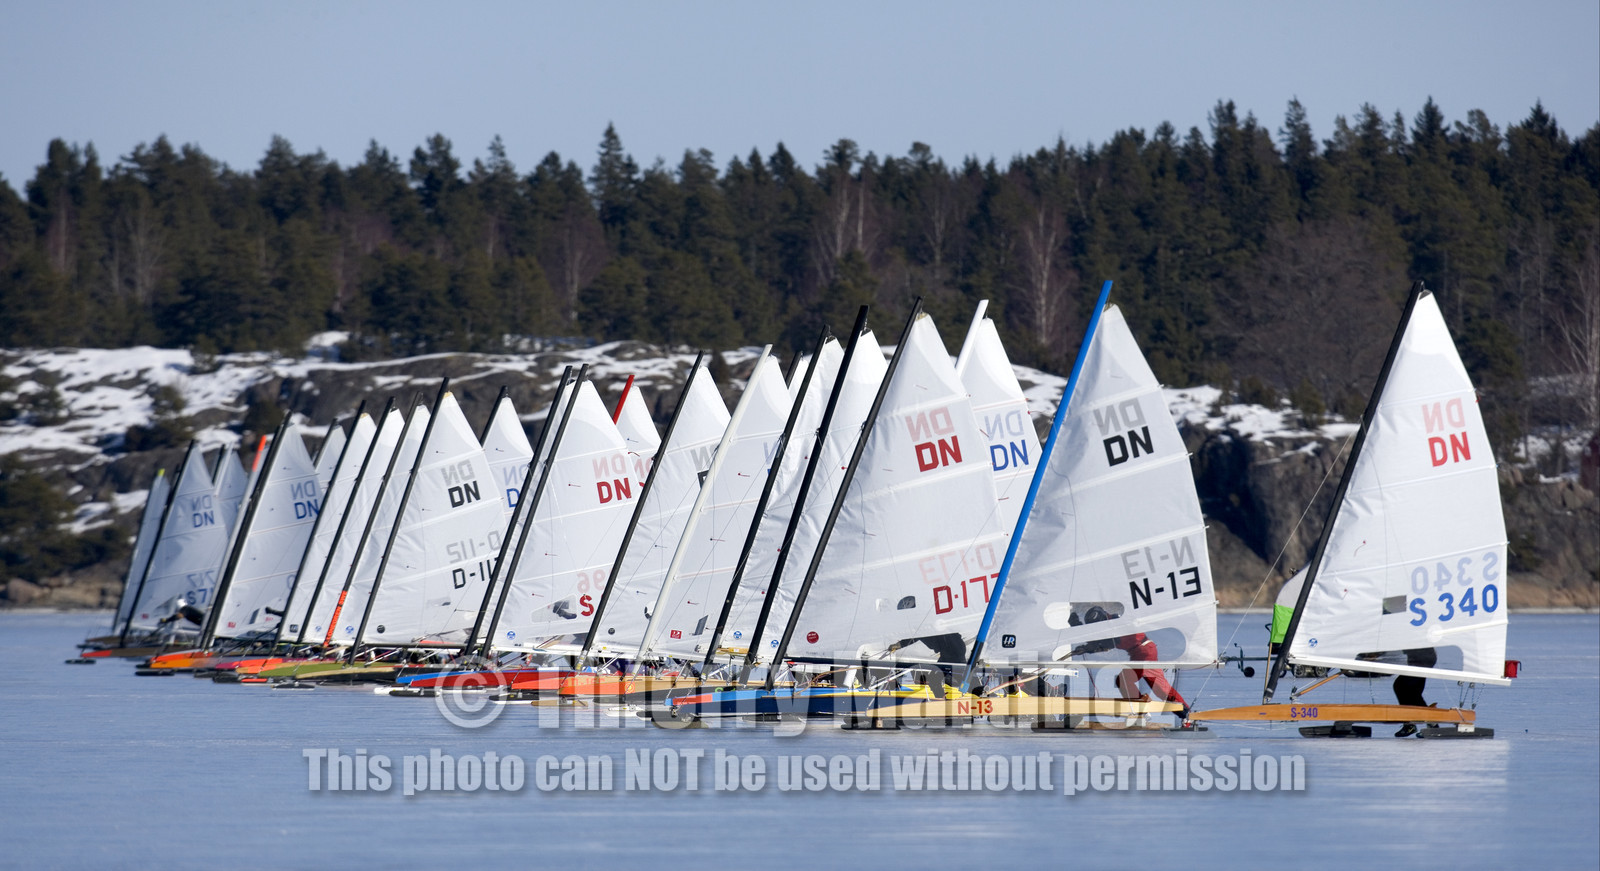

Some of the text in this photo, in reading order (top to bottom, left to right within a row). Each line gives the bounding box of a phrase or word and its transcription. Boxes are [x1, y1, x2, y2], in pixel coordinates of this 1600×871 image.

[914, 435, 962, 472] DN
[989, 439, 1030, 472] DN
[1103, 425, 1154, 467] DN
[1427, 431, 1471, 467] DN
[448, 480, 481, 508] DN
[506, 487, 521, 508] D
[596, 477, 632, 504] DN
[193, 510, 215, 528] DN
[293, 499, 320, 519] DN
[452, 557, 499, 590] D-11
[1129, 566, 1202, 610] N-13
[579, 594, 595, 617] S
[1410, 584, 1499, 626] S 340
[957, 700, 993, 715] N-13
[1290, 706, 1318, 718] S-340
